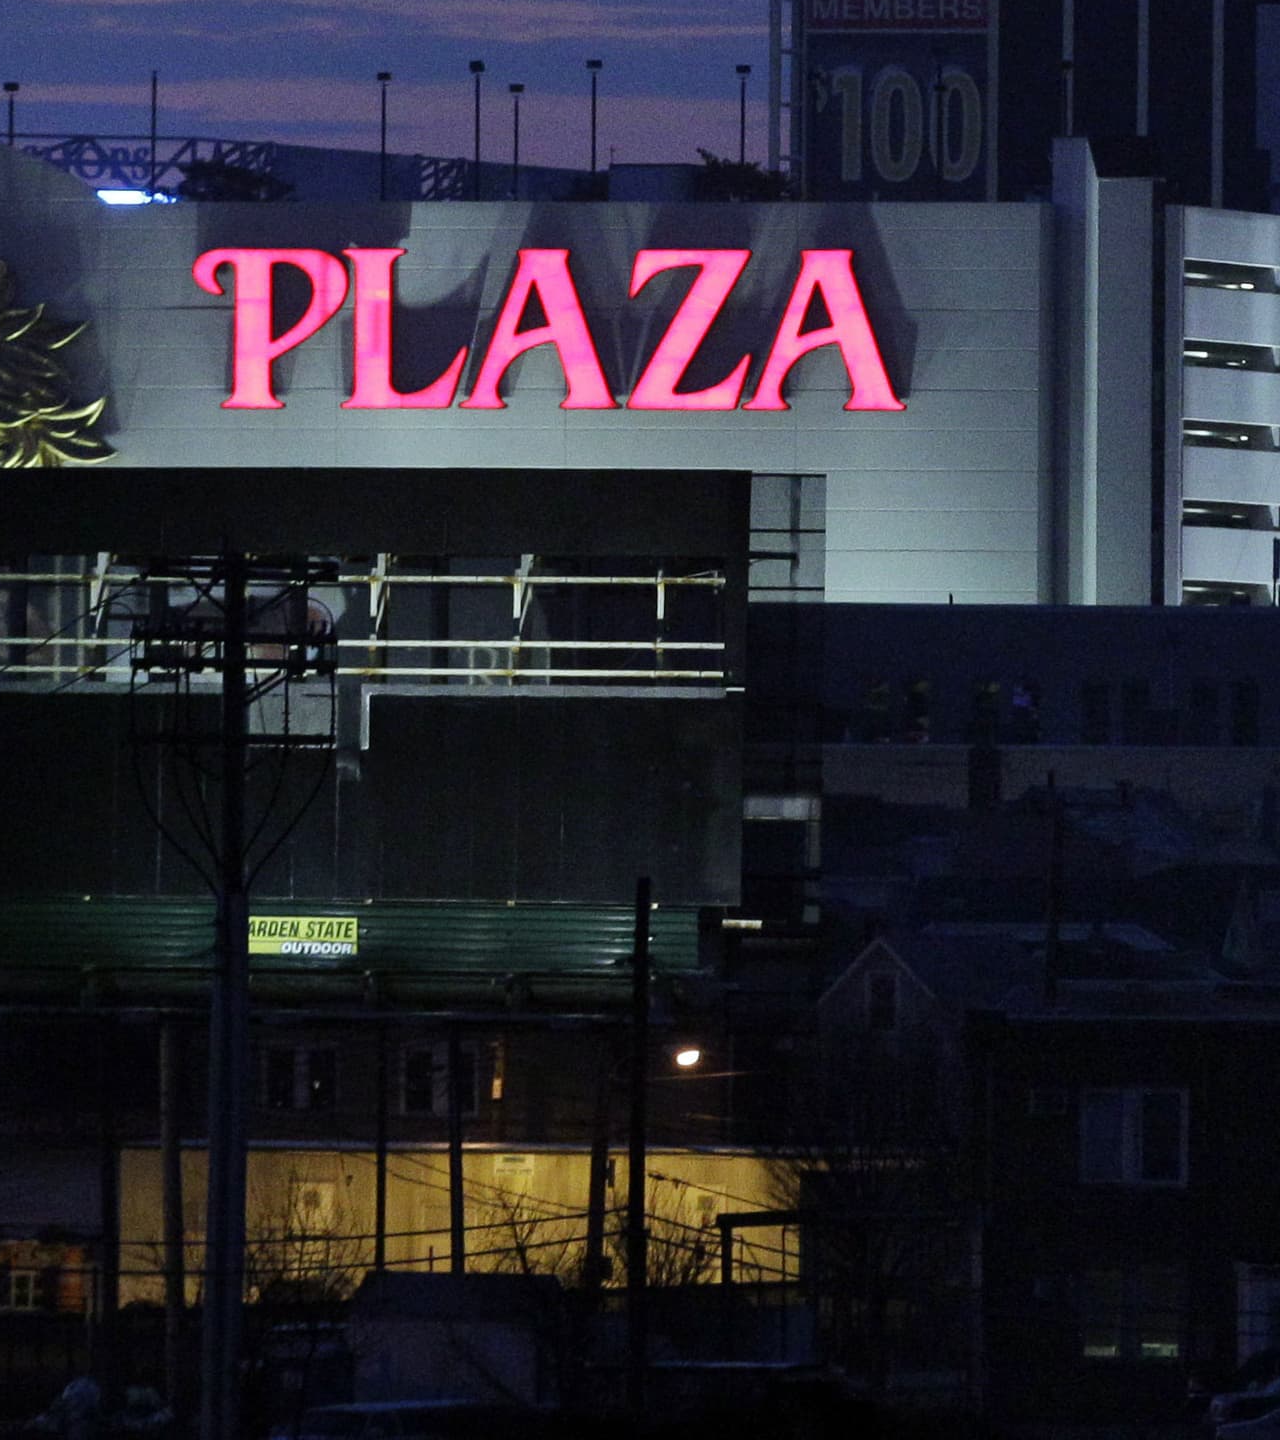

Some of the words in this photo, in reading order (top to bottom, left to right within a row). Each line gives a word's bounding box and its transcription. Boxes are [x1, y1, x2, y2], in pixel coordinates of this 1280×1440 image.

[192, 247, 906, 412] PLAZA
[248, 920, 300, 938] ARDEN
[306, 921, 353, 939] STATE
[271, 941, 353, 955] OUTDOOR
